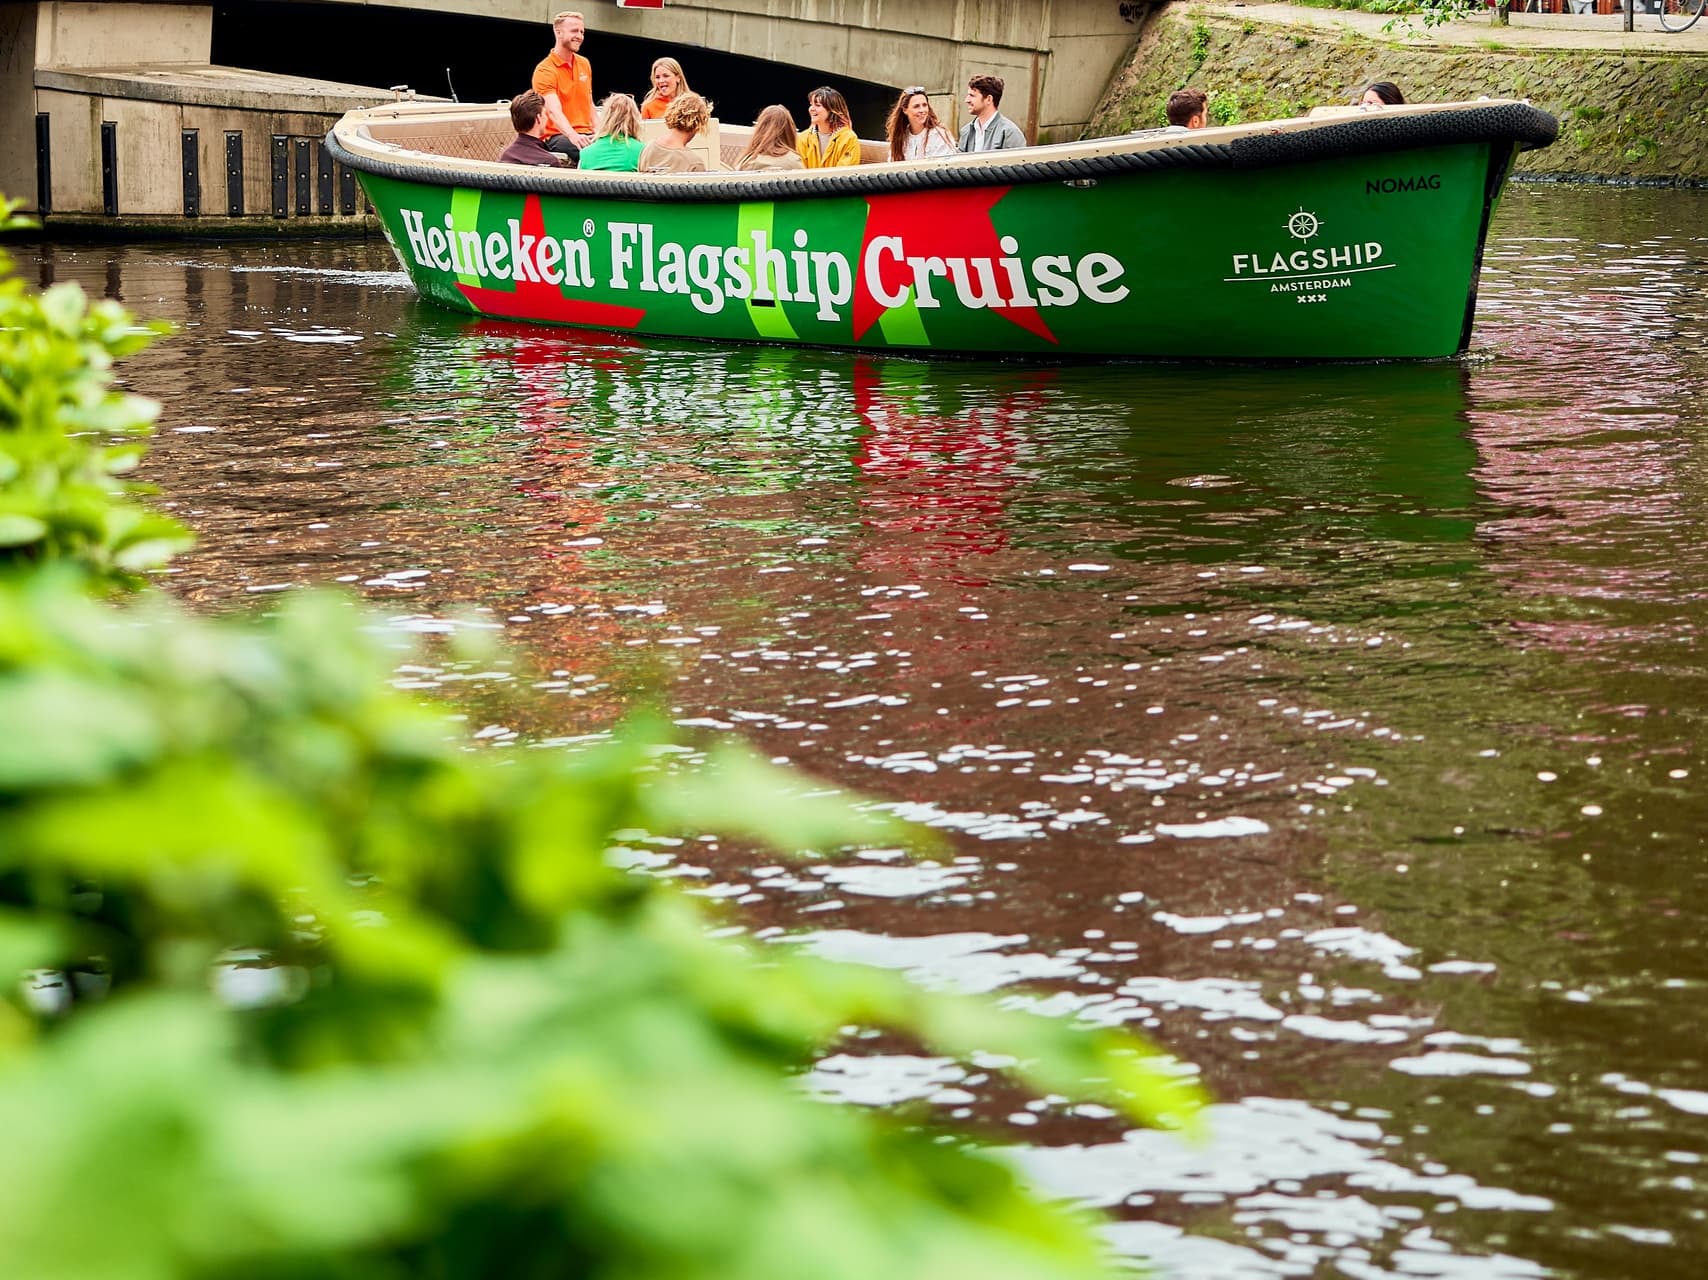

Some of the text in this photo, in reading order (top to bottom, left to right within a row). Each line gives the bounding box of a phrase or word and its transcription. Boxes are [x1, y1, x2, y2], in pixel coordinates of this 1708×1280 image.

[1365, 174, 1441, 195] NOMAG
[1232, 241, 1384, 274] FLAGSHIP
[607, 221, 852, 322] Flagship
[864, 235, 1130, 309] Cruise
[1270, 277, 1351, 293] AMSTERDAM
